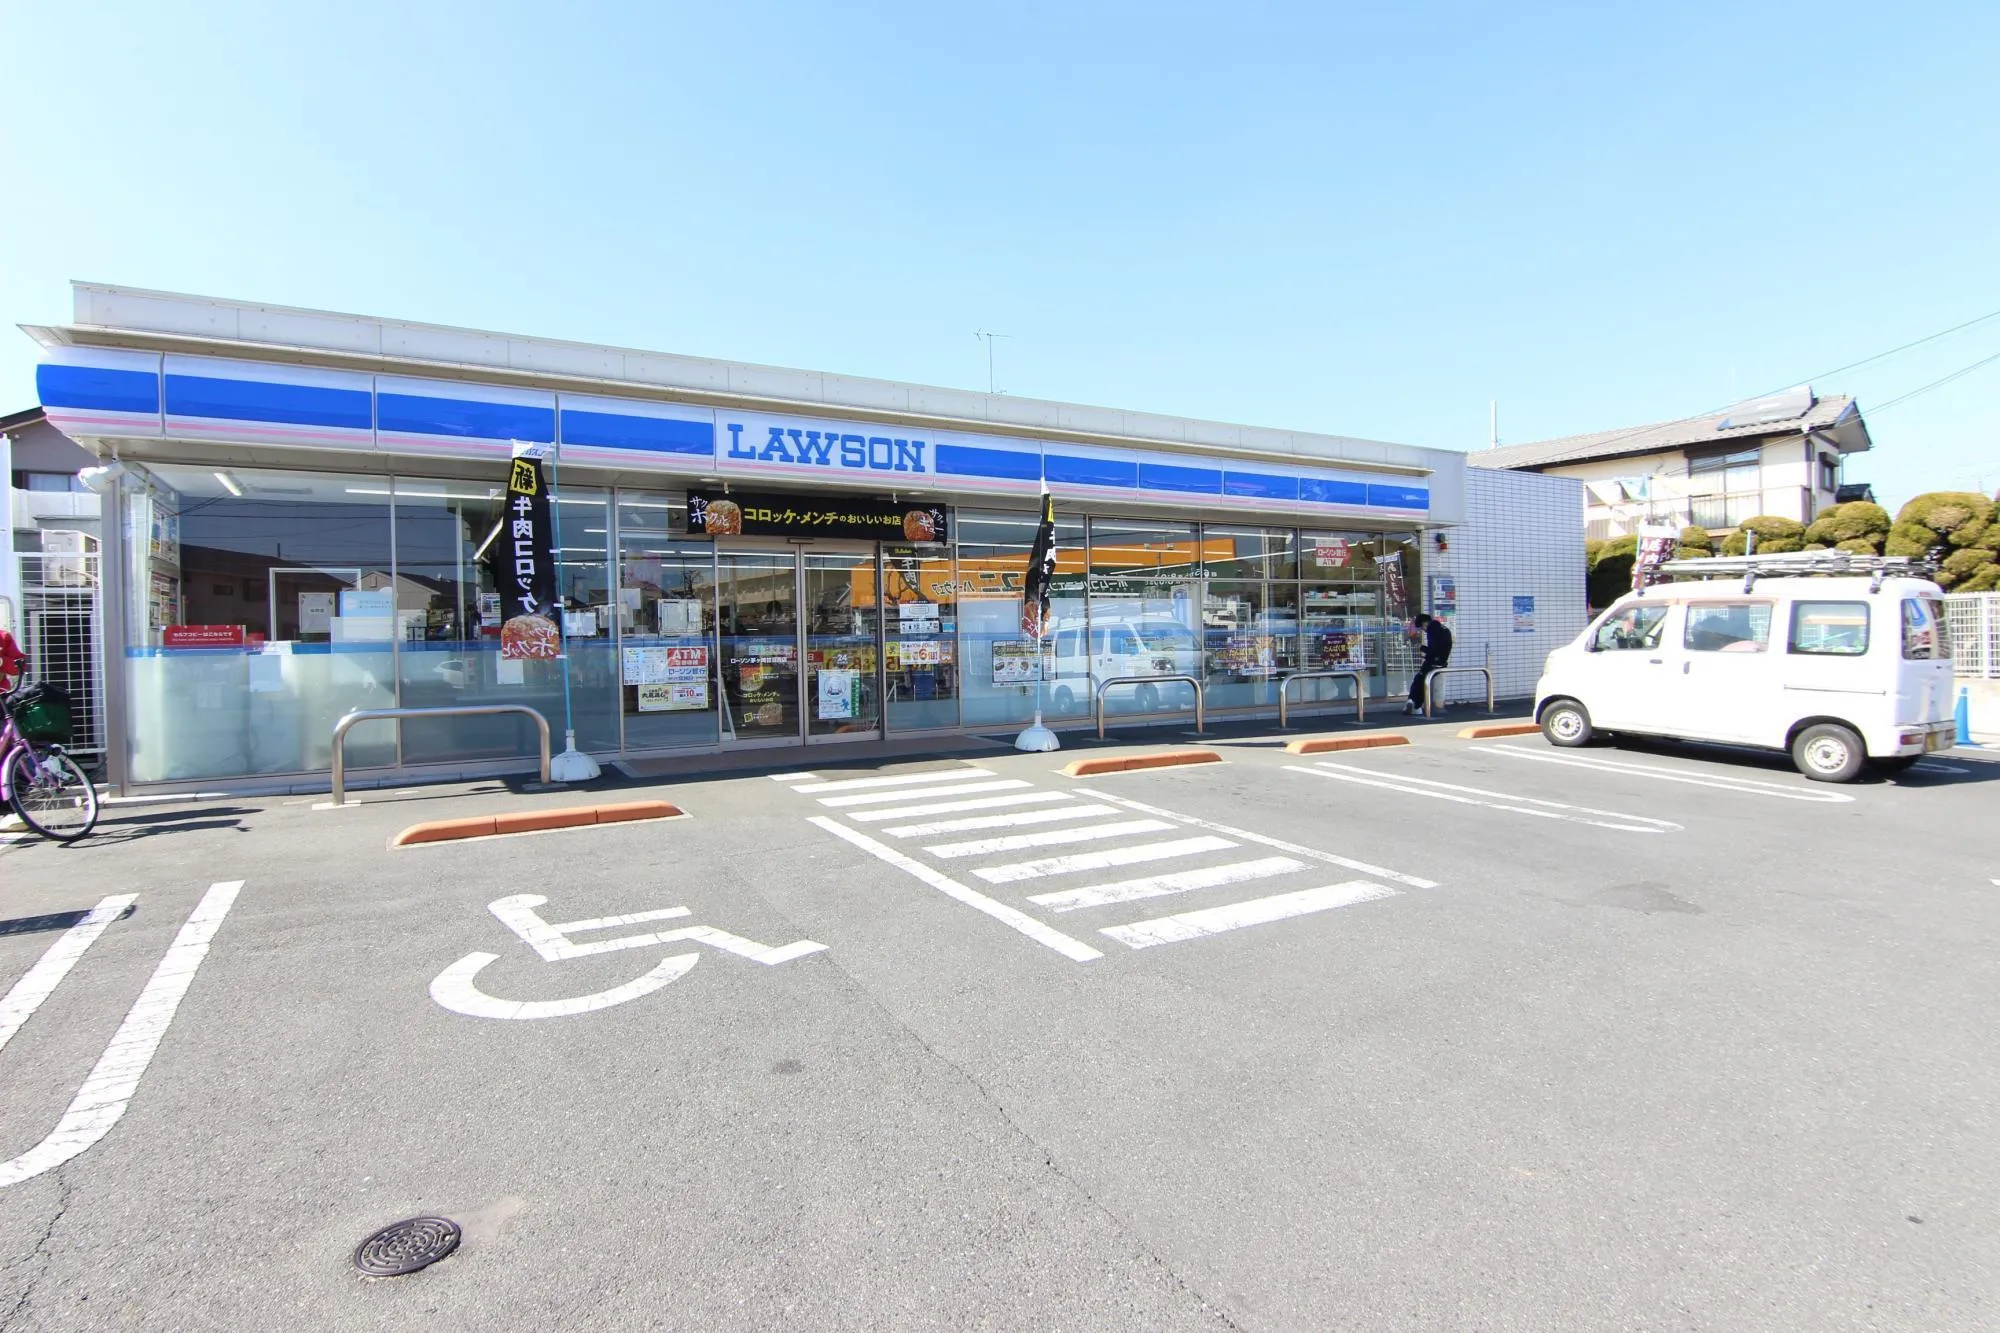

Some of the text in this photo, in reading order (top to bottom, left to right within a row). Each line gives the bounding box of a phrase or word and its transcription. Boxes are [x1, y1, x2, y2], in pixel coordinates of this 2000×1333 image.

[727, 424, 926, 472] LAWSON
[1322, 558, 1336, 566] ATM
[672, 650, 701, 659] ATM
[668, 667, 705, 676] ローソン銀行
